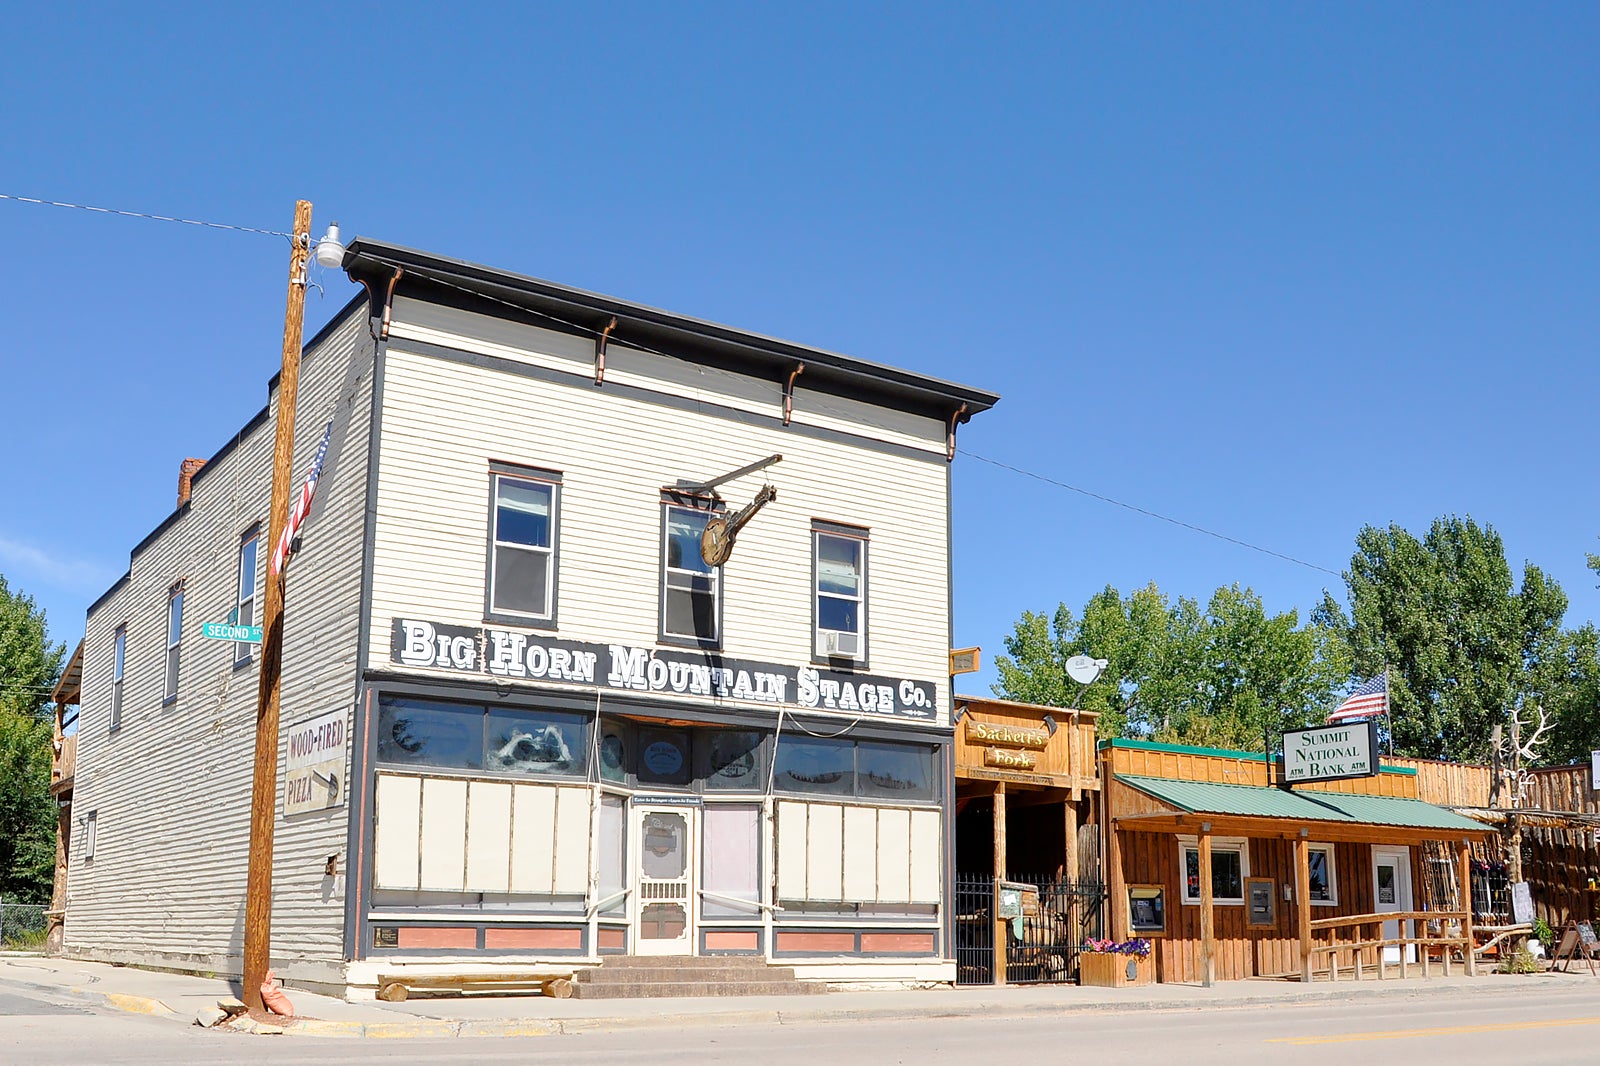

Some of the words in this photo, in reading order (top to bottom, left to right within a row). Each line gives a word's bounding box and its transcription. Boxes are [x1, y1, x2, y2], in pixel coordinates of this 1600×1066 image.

[207, 624, 249, 639] SECOND
[489, 630, 597, 682] HORN
[608, 644, 788, 703] MOUNTAIN
[797, 667, 895, 714] STAGE
[290, 719, 344, 757] WOOD-FIRED
[1302, 731, 1351, 746] SUMMIT
[1296, 747, 1360, 762] NATIONAL
[1290, 768, 1304, 776] ATM
[1310, 763, 1346, 776] BANK
[287, 776, 313, 804] PIZZA
